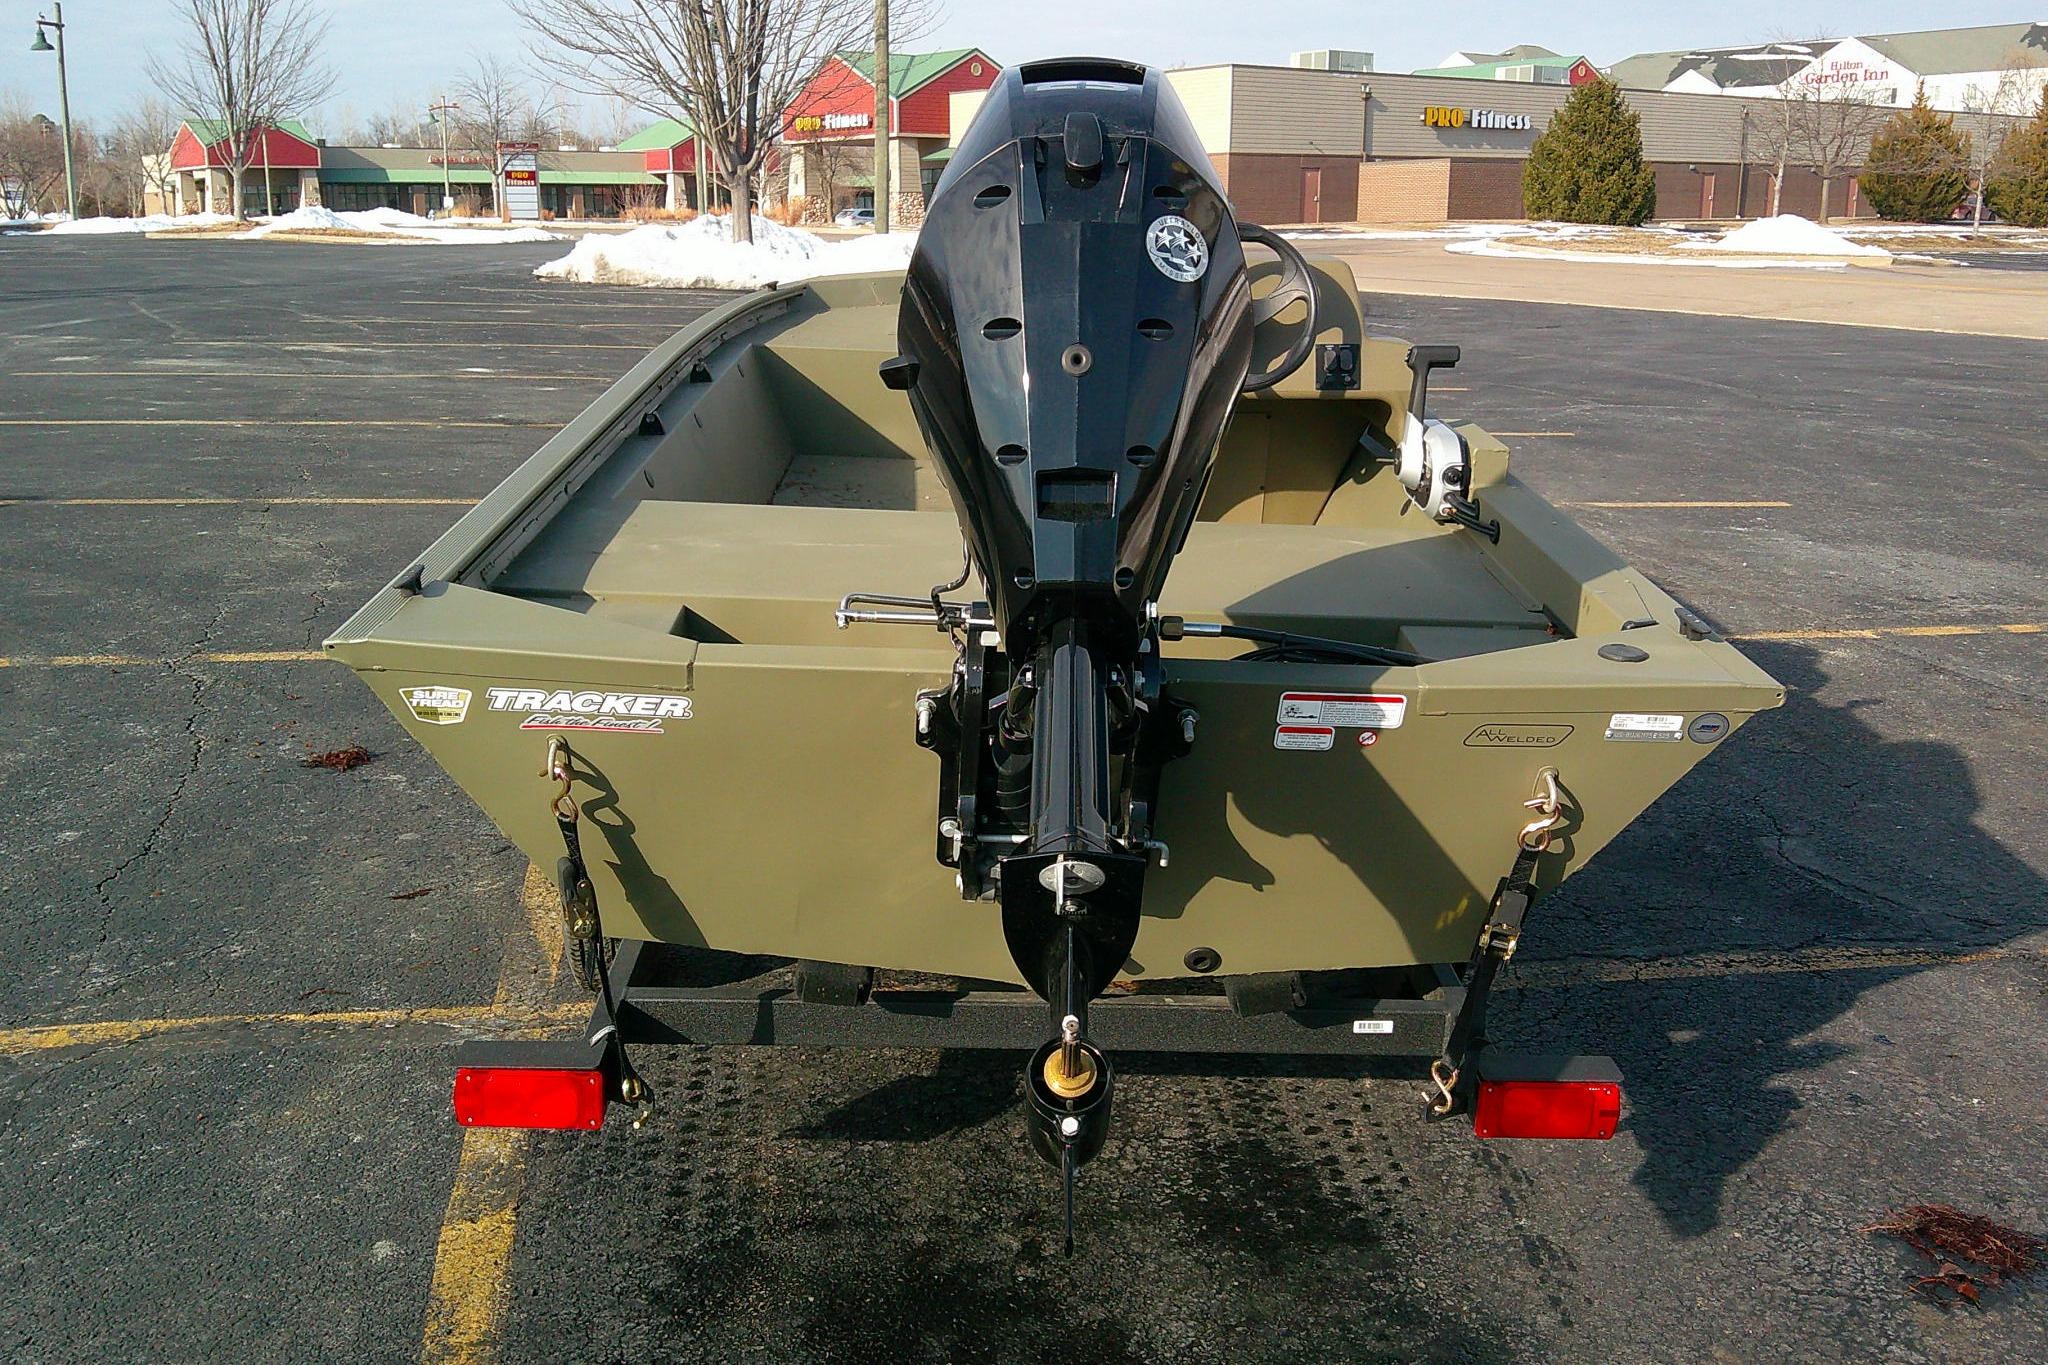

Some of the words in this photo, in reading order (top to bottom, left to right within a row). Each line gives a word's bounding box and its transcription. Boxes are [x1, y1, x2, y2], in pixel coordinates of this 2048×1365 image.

[1830, 61, 1863, 71] Hilton
[1805, 69, 1858, 84] Garden
[1863, 69, 1889, 81] Inn
[1425, 106, 1465, 128] PRO
[1471, 109, 1531, 130] Fitness
[511, 171, 529, 179] PRO
[506, 179, 535, 187] Fitness
[1191, 227, 1206, 248] LOW
[412, 690, 459, 700] SURE
[408, 699, 465, 708] TREAD
[526, 715, 562, 725] Fish
[564, 716, 589, 726] the
[1475, 729, 1506, 738] ALL
[1488, 735, 1556, 743] WELDED
